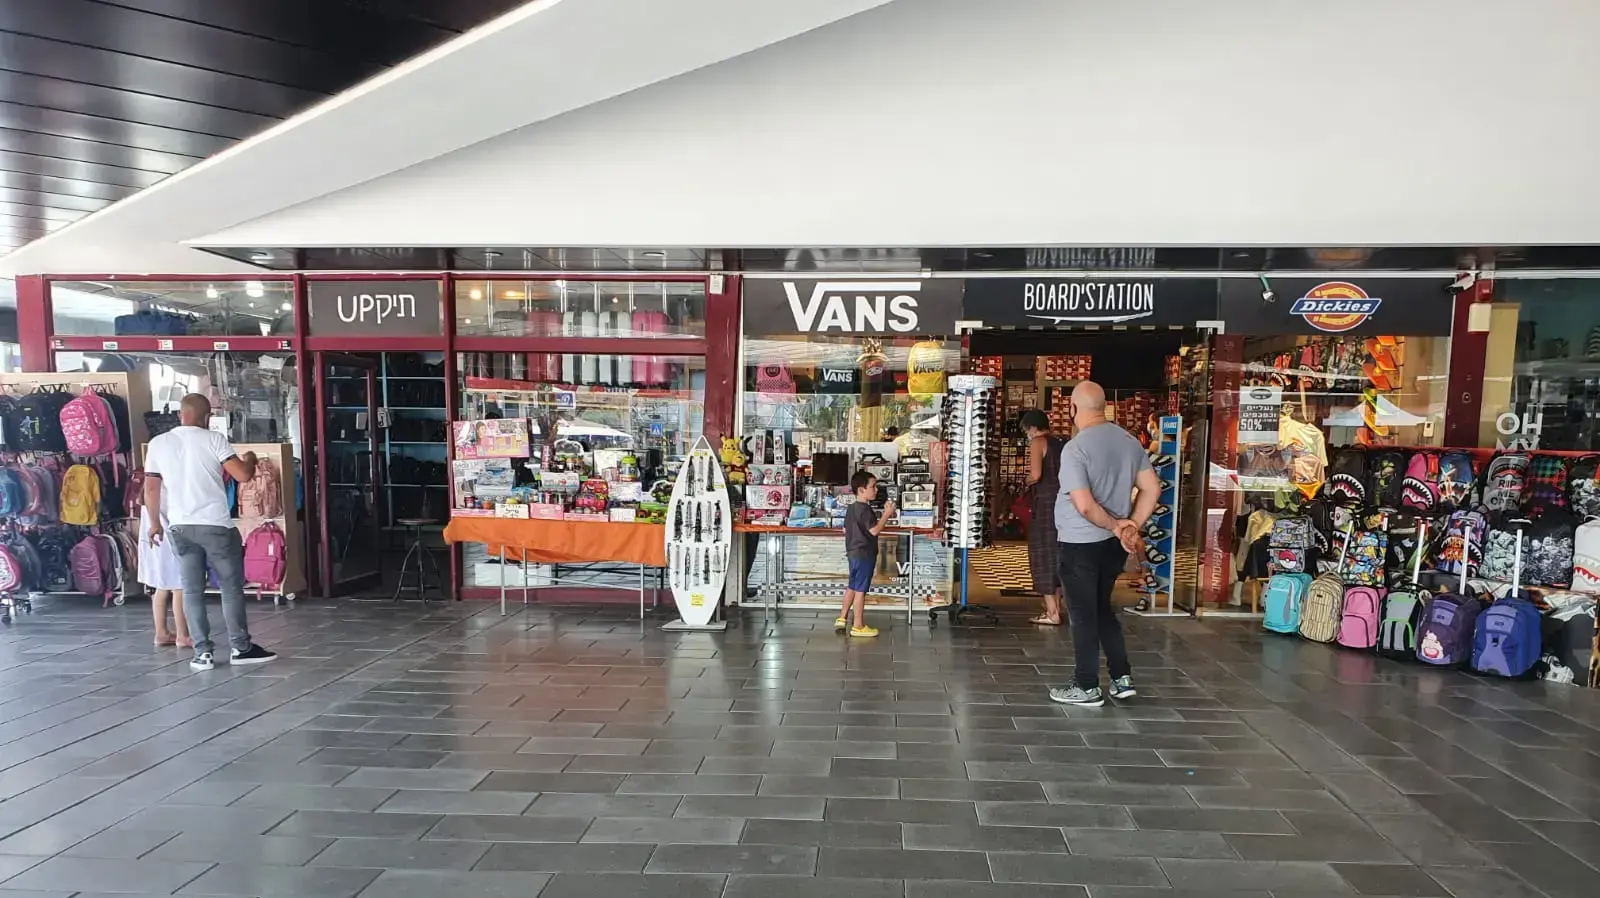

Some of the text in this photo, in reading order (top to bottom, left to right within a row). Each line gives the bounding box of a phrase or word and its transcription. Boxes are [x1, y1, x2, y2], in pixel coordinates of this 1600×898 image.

[1023, 282, 1154, 311] BOARD'STATION
[1299, 300, 1372, 312] Dickies
[783, 281, 922, 332] VANS
[822, 368, 854, 383] VANS
[1240, 418, 1263, 430] 50%
[1495, 412, 1543, 435] OH
